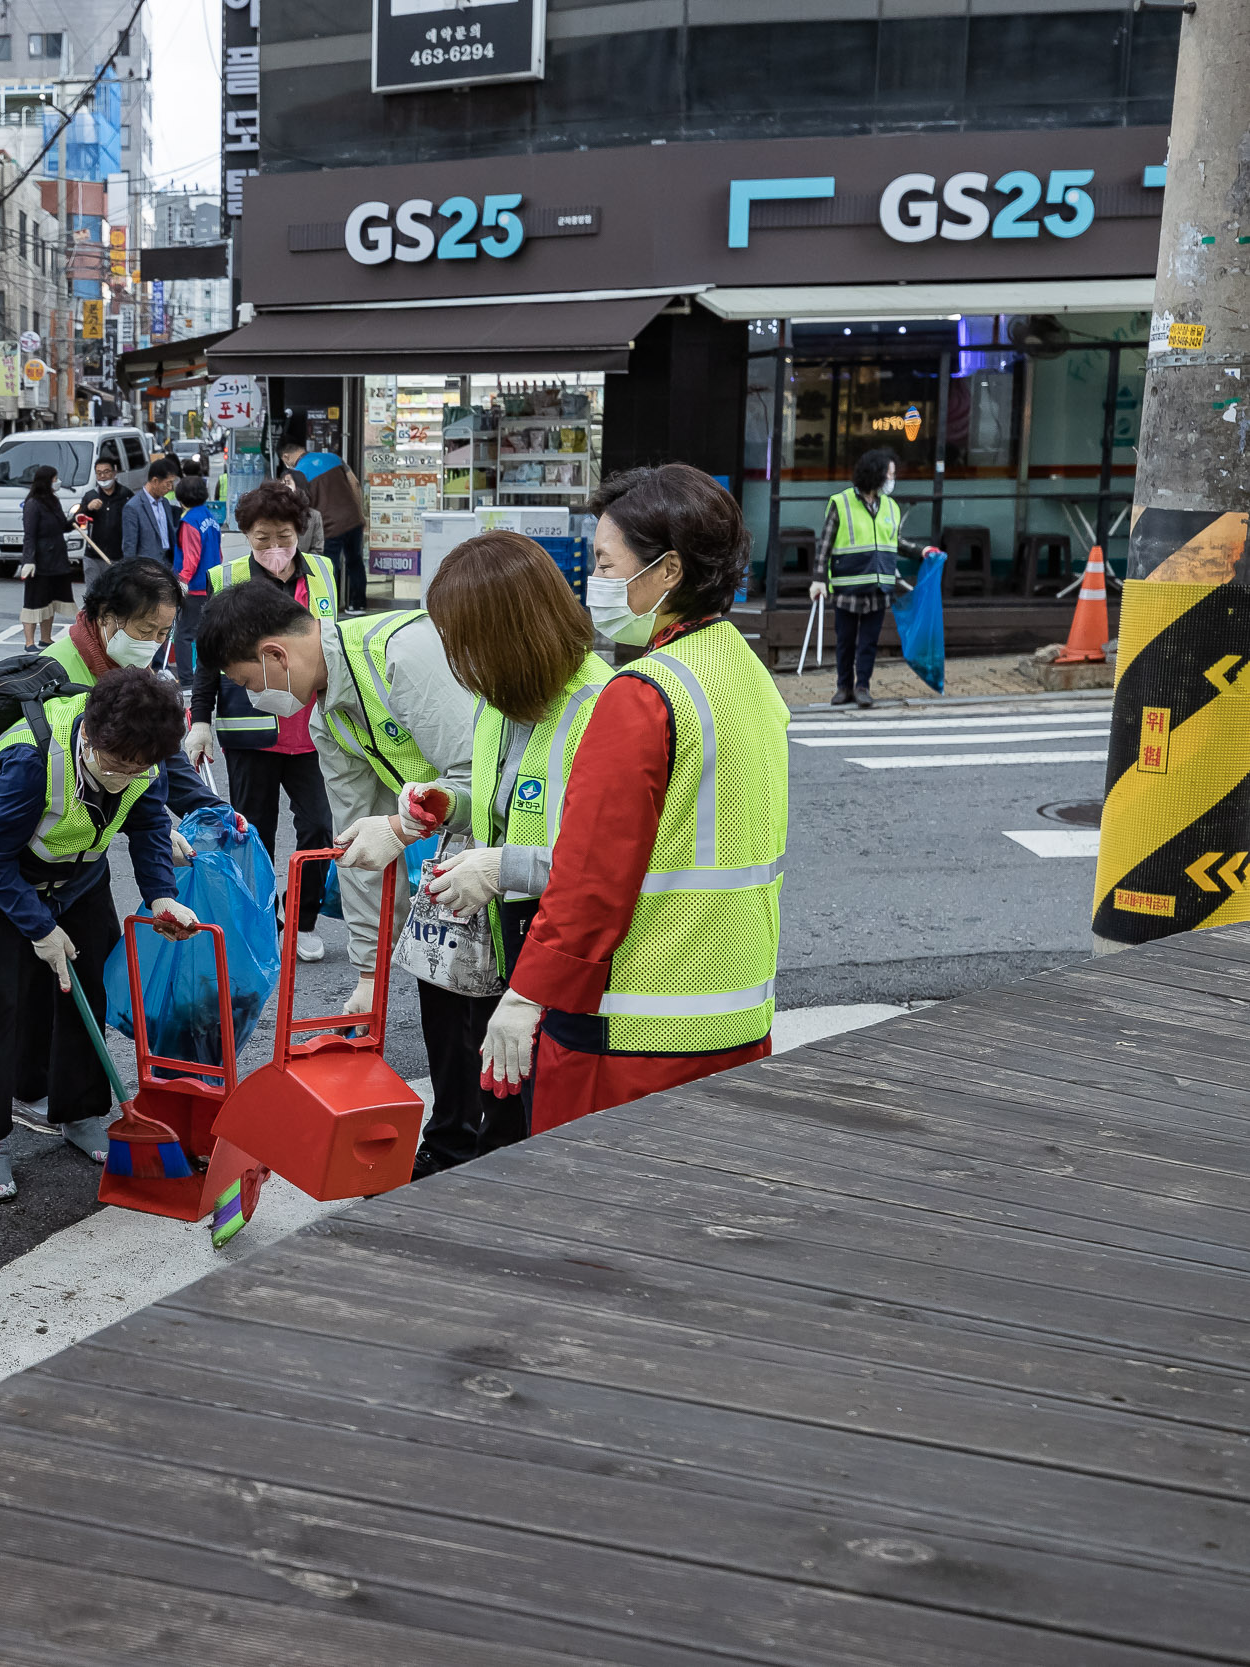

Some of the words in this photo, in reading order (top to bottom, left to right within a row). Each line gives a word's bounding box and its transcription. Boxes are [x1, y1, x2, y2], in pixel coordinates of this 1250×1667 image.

[426, 23, 481, 44] 예약문의
[879, 168, 1095, 243] GS25
[345, 194, 524, 265] GS25
[218, 379, 248, 396] Jeju
[217, 401, 254, 419] 포차
[525, 527, 562, 536] CAFE25
[1143, 711, 1164, 767] 위험
[516, 799, 541, 810] 광진구
